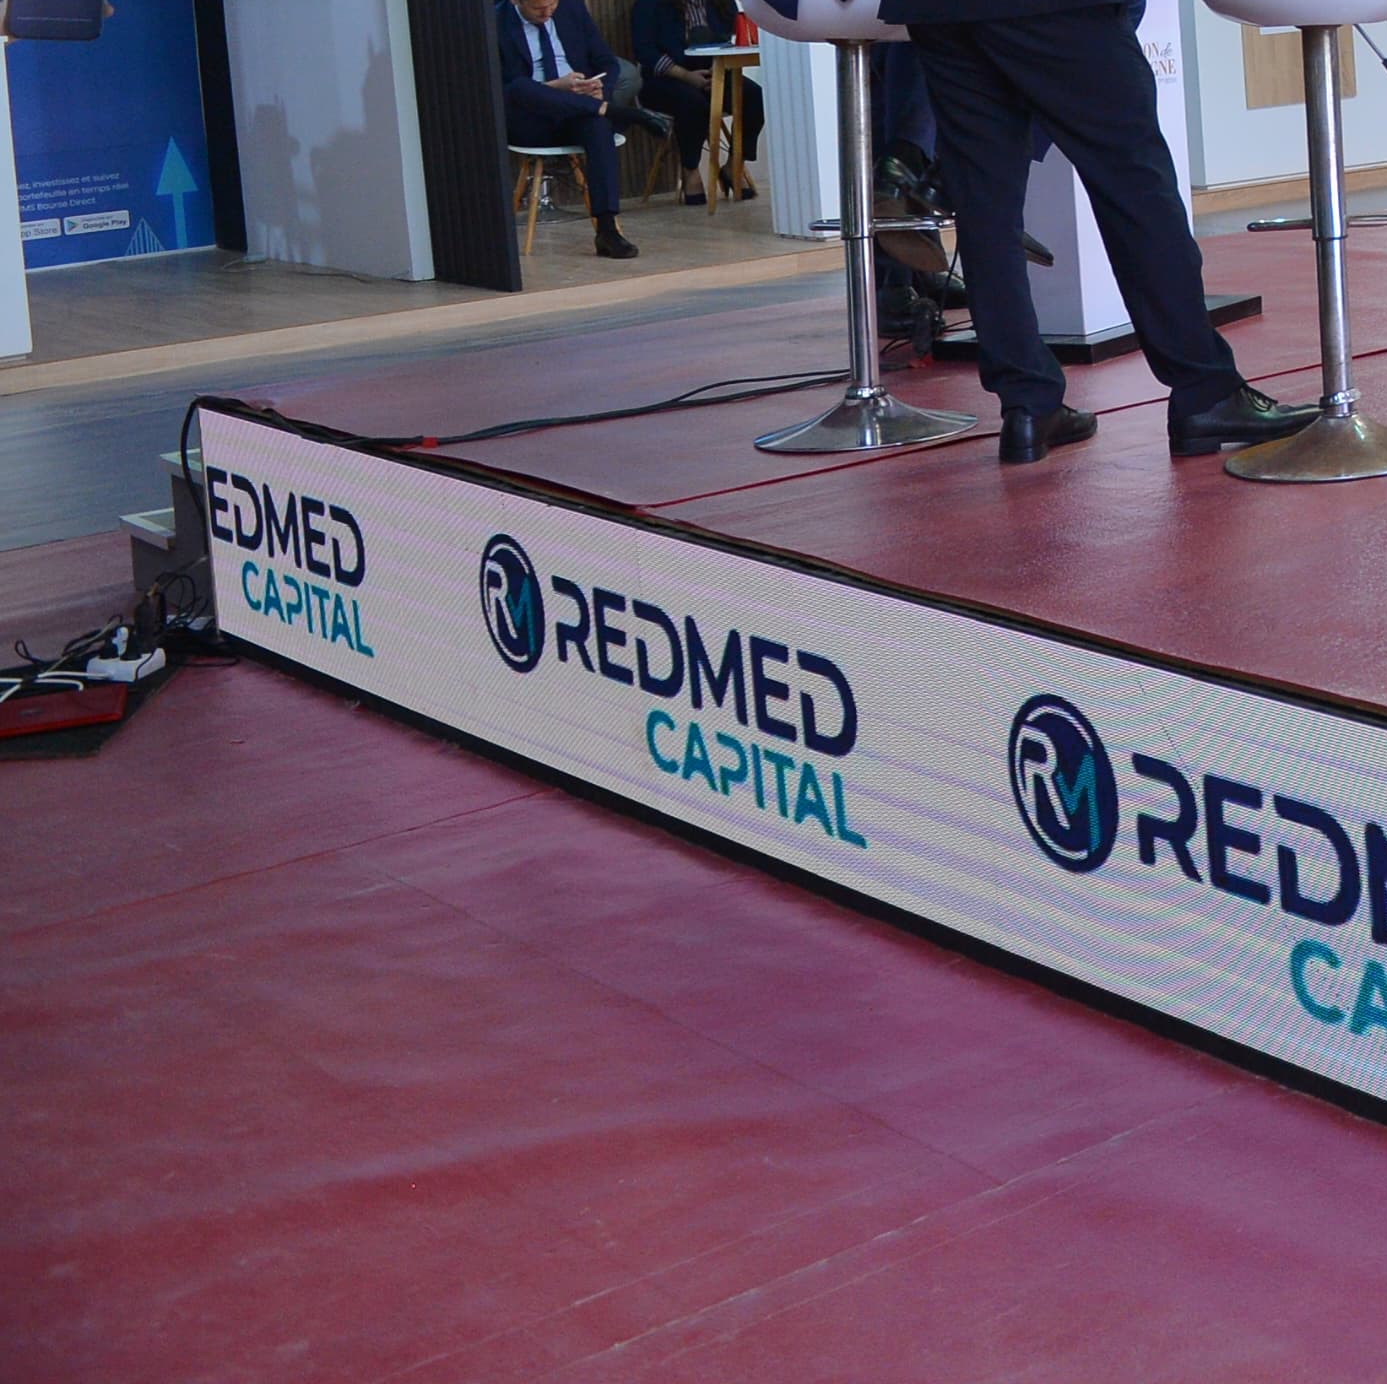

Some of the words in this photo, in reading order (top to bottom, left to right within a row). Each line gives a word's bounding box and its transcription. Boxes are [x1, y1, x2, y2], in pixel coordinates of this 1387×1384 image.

[70, 198, 96, 208] Direct
[83, 221, 110, 230] Google
[112, 219, 127, 228] Play
[206, 466, 366, 588] EDMED
[242, 561, 375, 658] CAPITAL
[552, 574, 858, 758] REDMED
[644, 709, 868, 850] CAPITAL
